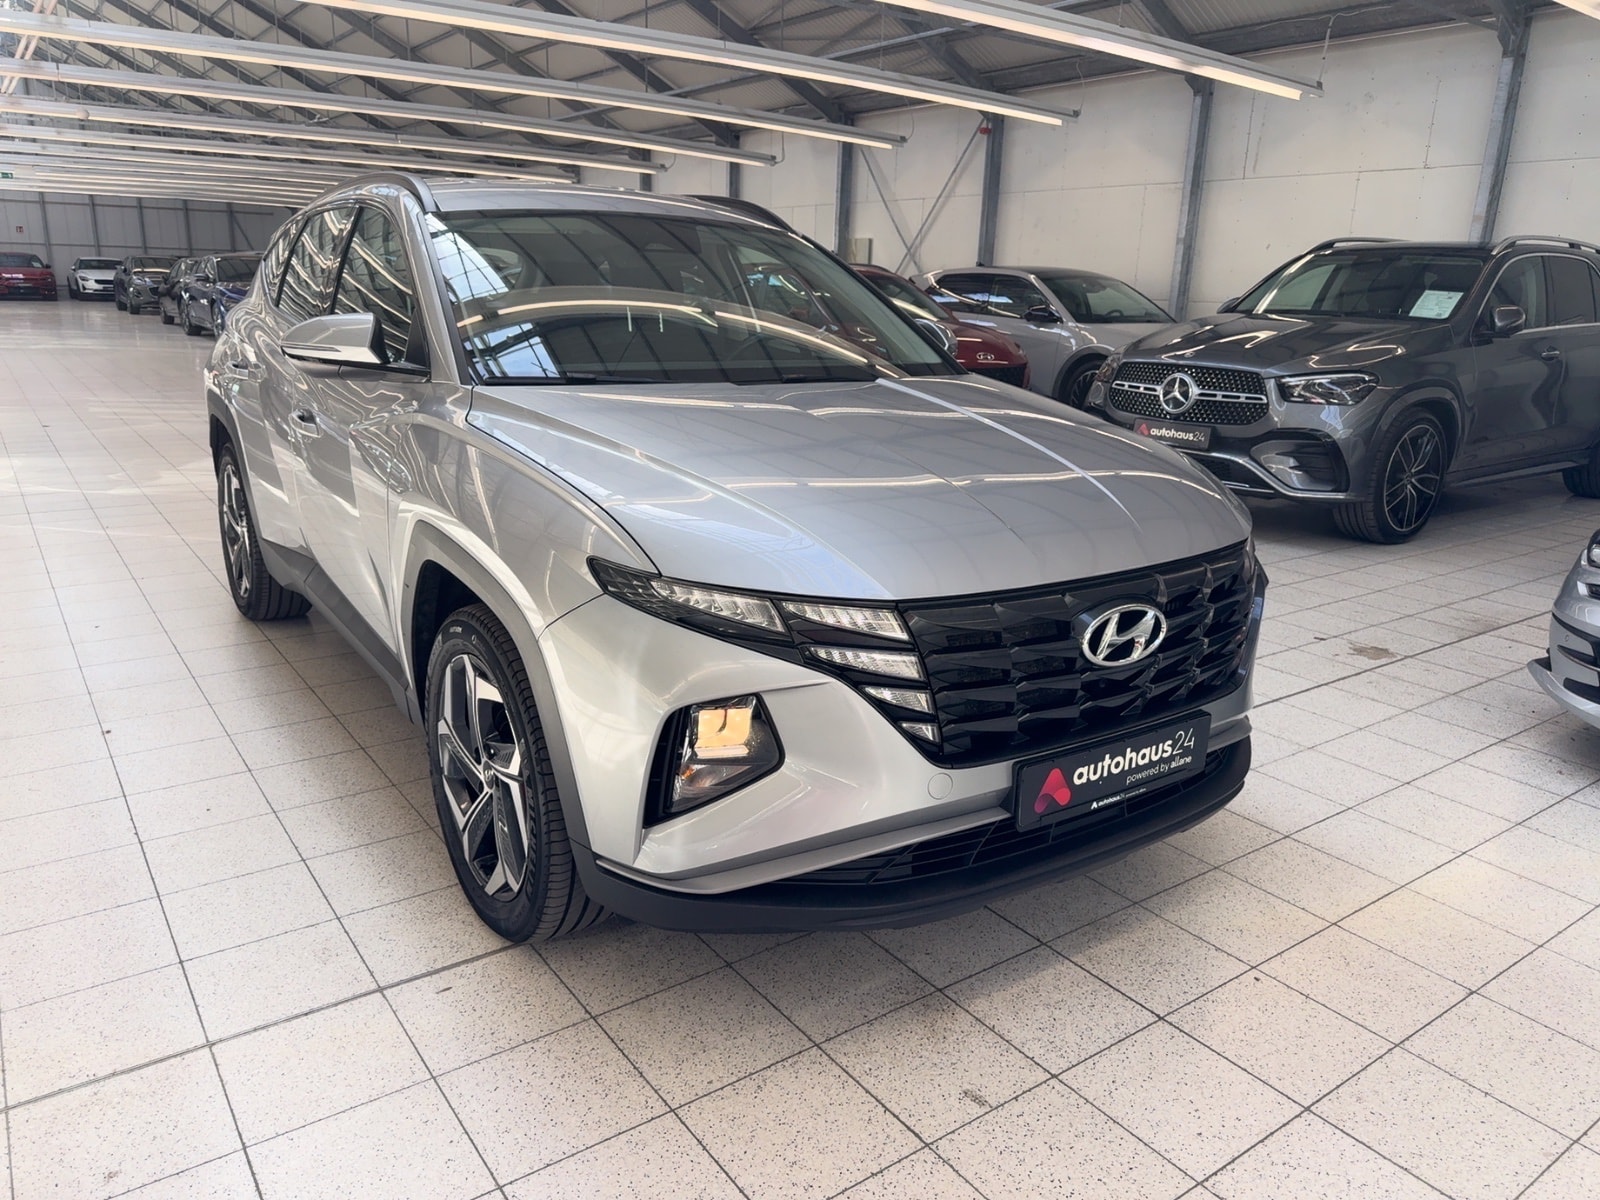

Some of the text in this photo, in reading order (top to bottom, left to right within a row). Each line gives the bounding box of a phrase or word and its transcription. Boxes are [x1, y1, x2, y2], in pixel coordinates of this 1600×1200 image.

[1150, 427, 1205, 442] autohaus24
[1072, 727, 1195, 785] autohaus24
[1126, 756, 1192, 785] powered by allane
